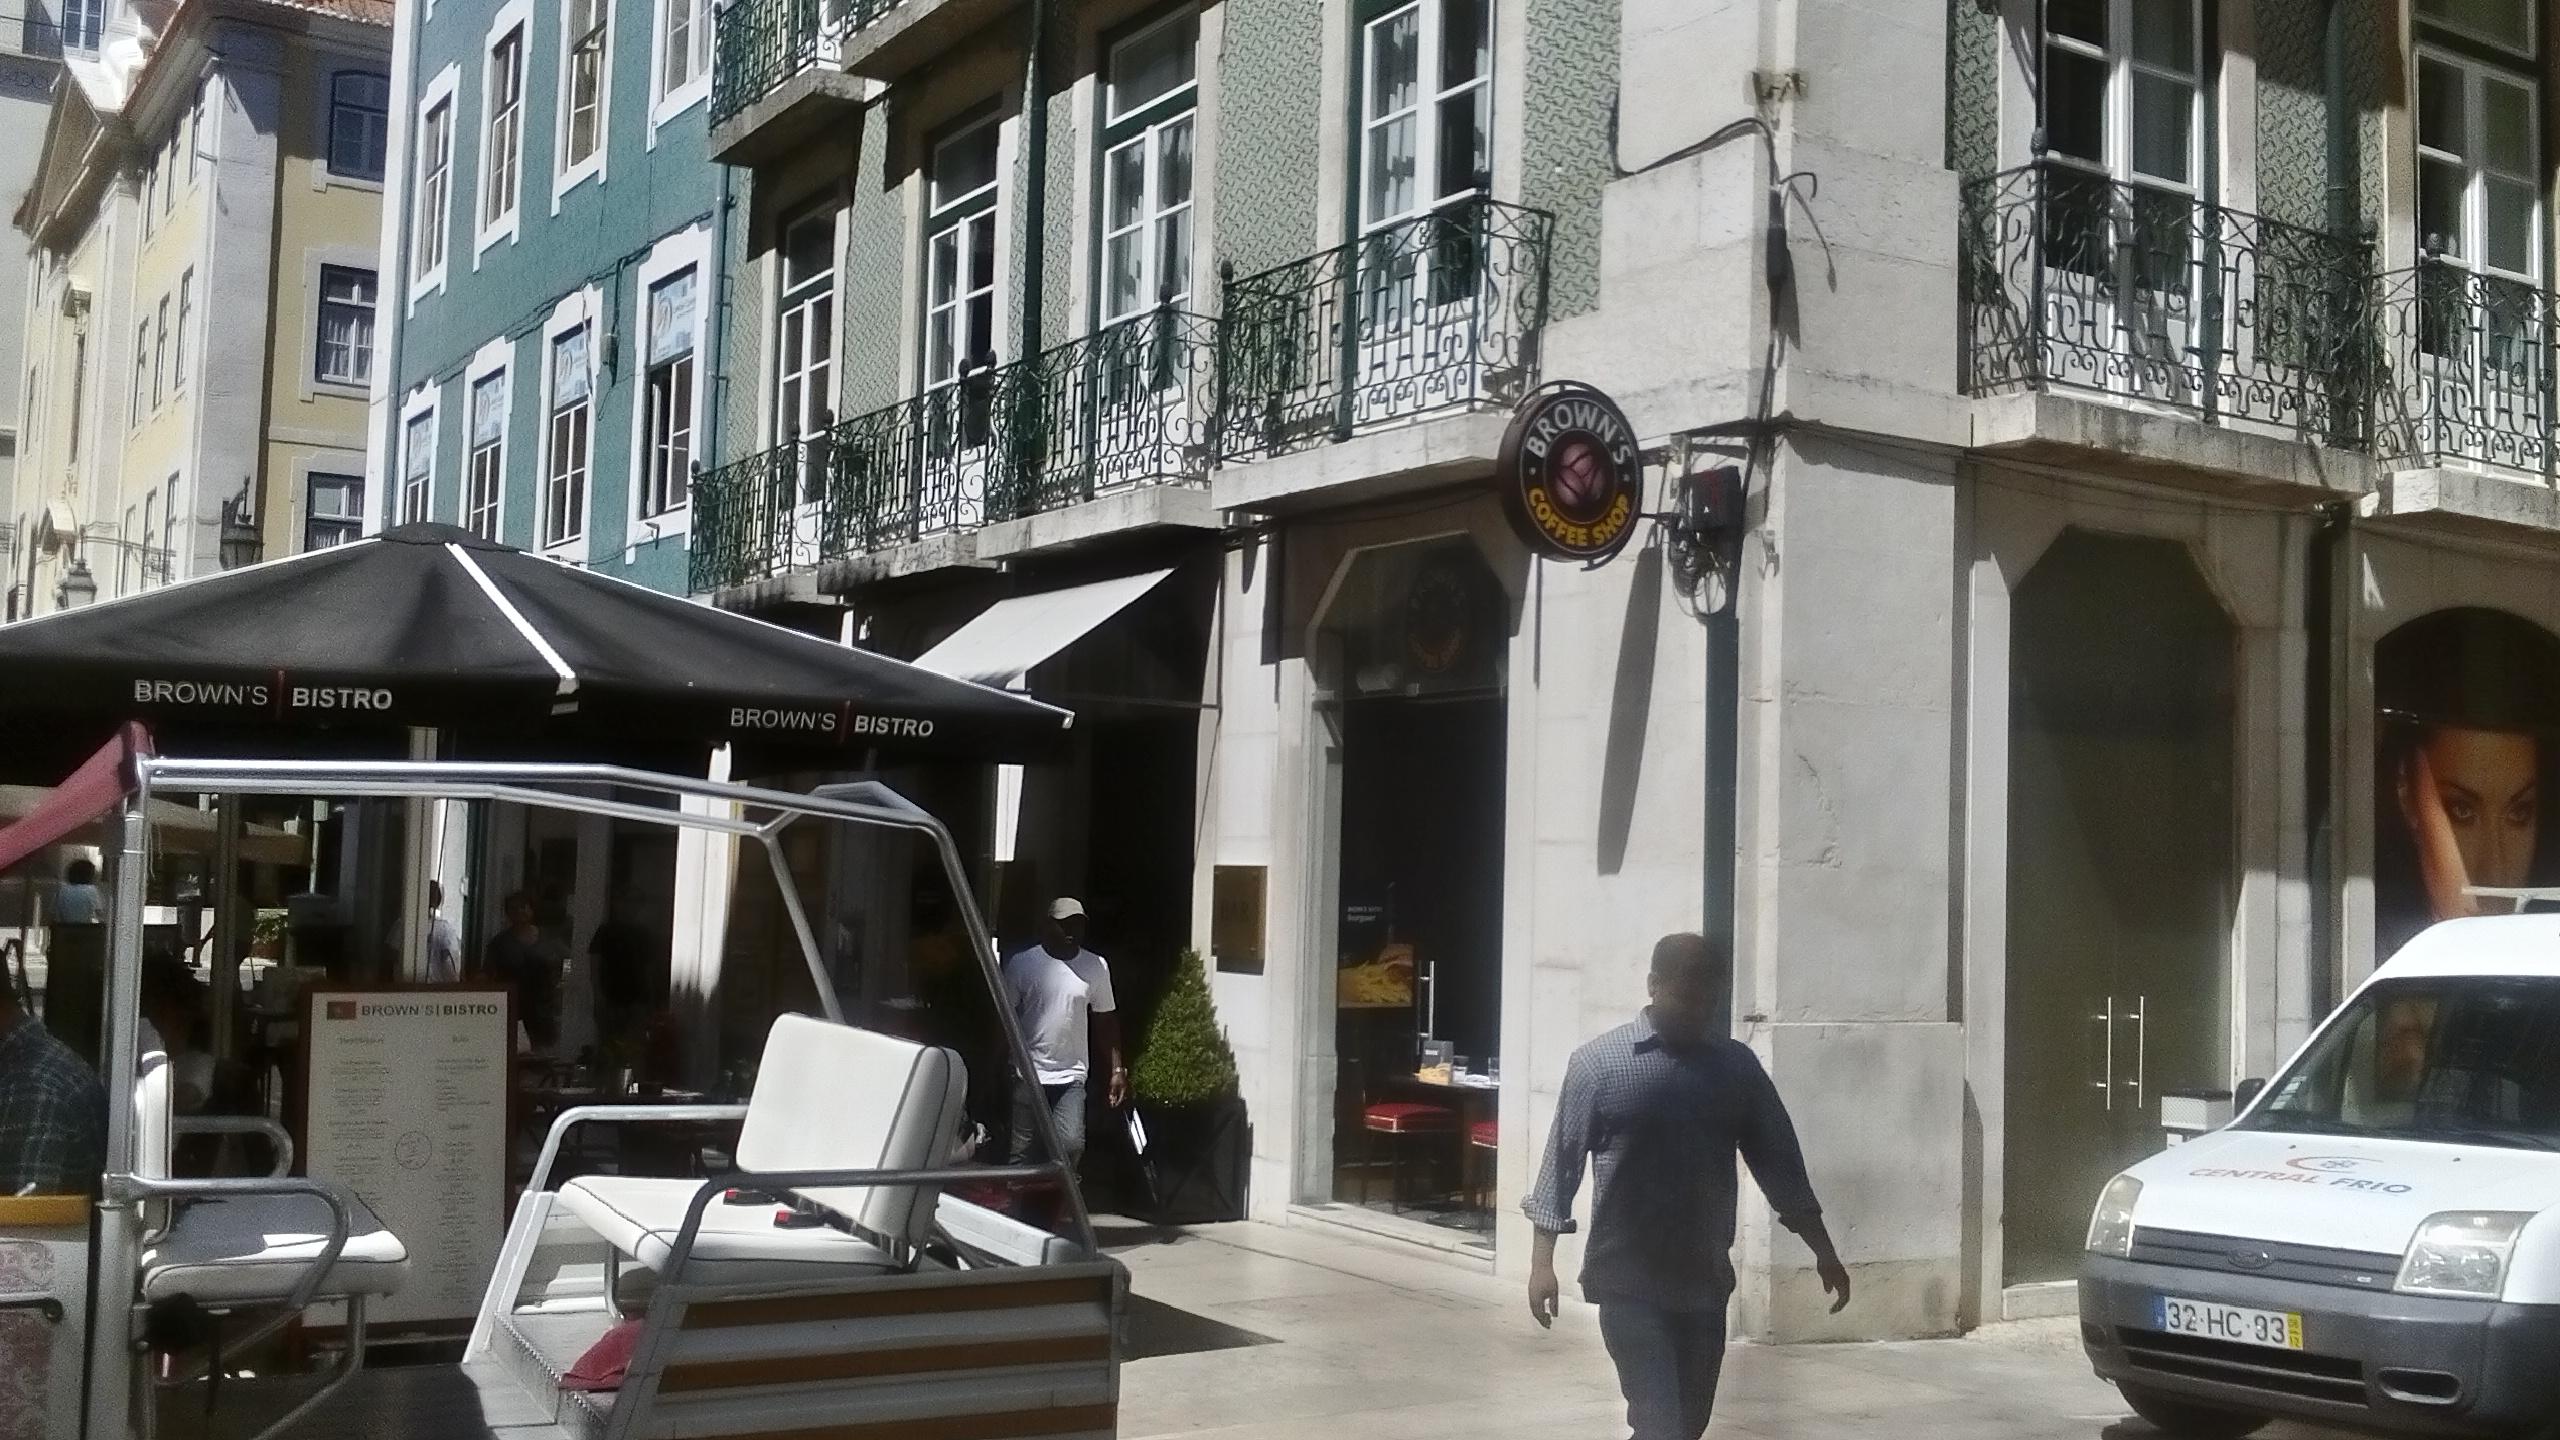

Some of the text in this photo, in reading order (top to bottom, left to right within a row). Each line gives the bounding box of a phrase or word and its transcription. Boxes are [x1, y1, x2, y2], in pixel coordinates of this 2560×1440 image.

[1525, 401, 1632, 465] BROWN'S
[1529, 487, 1631, 546] COFFEE SHOP
[133, 678, 393, 710] BROWN'S BISTRO
[729, 707, 935, 738] BROWN'S BISTRO
[442, 1003, 499, 1017] BISTRO
[2188, 1168, 2413, 1194] CENTRAL FRIO
